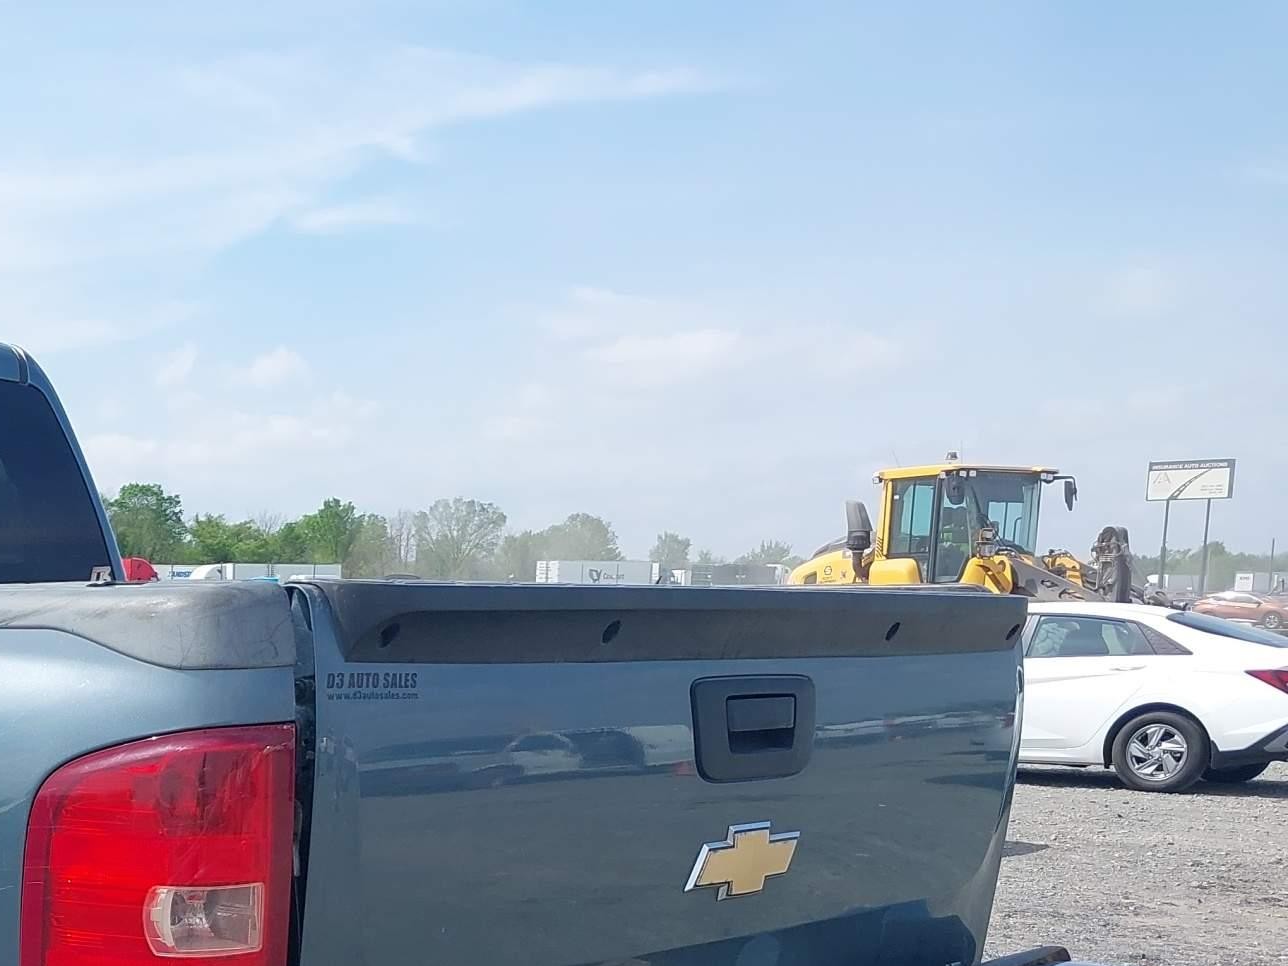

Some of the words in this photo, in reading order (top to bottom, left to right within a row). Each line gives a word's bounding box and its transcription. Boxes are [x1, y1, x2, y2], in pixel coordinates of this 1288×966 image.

[326, 672, 345, 689] D3
[348, 672, 380, 689] AUTO
[382, 672, 418, 689] SALES
